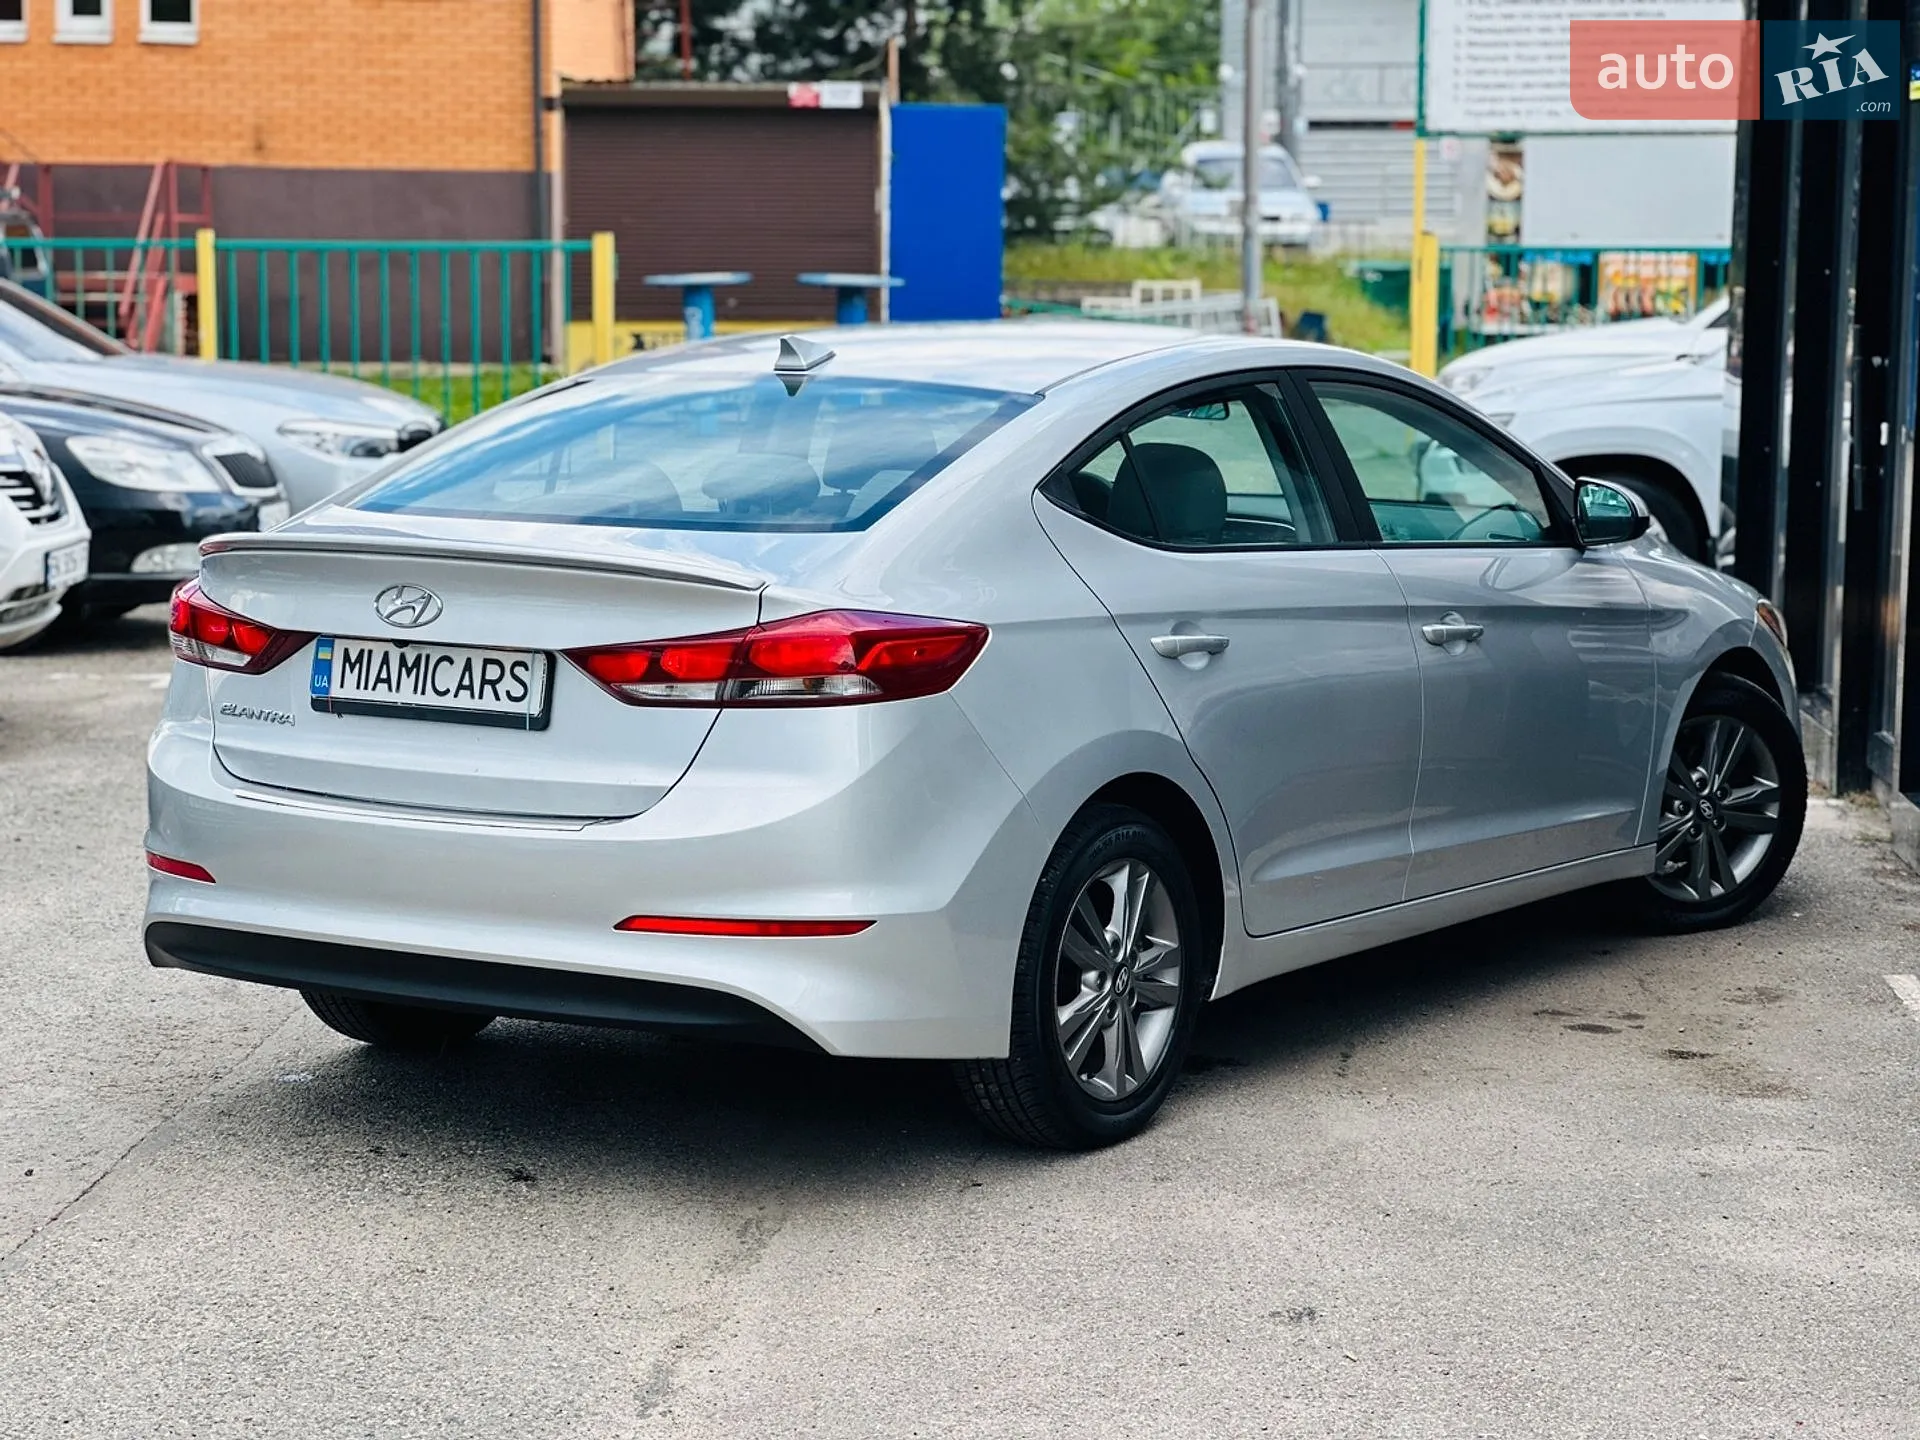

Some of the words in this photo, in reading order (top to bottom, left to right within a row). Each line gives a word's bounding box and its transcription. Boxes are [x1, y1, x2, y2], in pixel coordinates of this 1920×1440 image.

[314, 673, 330, 689] UA
[339, 646, 531, 704] MIAMICARS
[219, 702, 296, 728] ELANTRA
